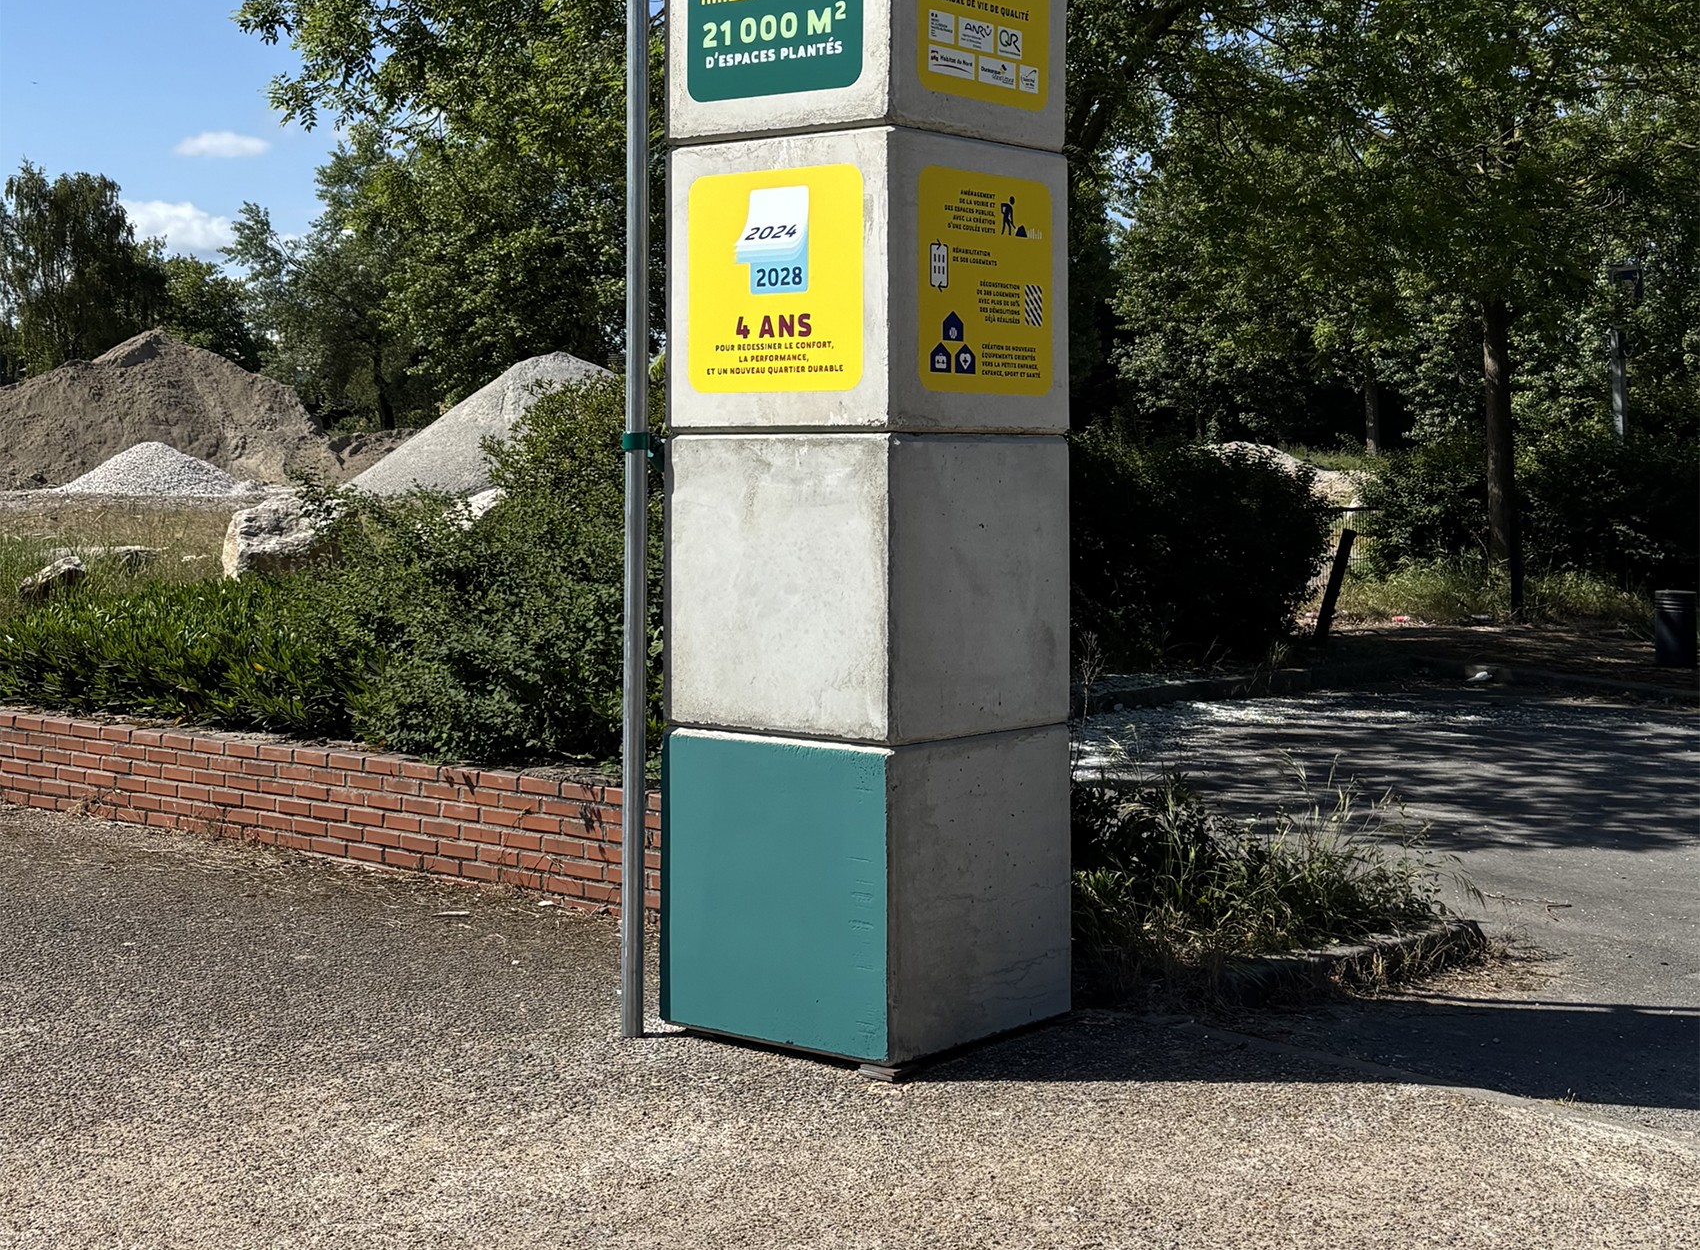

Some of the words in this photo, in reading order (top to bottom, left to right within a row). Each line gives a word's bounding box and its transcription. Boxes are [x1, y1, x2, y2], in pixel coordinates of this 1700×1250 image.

[977, 0, 988, 11] VIE
[990, 3, 999, 14] DE
[1000, 6, 1029, 21] QUALITÉ
[999, 29, 1021, 53] QR
[705, 48, 776, 69] D'ESPACES
[780, 37, 843, 60] PLANTÉS
[960, 188, 996, 199] AMÉNAGEMENT
[954, 206, 974, 214] ESPACES
[973, 216, 996, 225] CRÉATION
[744, 223, 797, 241] 2024
[962, 224, 981, 232] COULÉE
[952, 247, 991, 257] RÉHABILITATION
[969, 257, 998, 267] LOGEMENTS
[756, 266, 803, 287] 2028
[979, 279, 1020, 290] DÉCONSTRUCTION
[993, 291, 1020, 299] LOGEMENTS
[989, 306, 1020, 315] DÉMOLITIONS
[985, 314, 996, 323] DÉJÀ
[997, 315, 1020, 324] RÉALISÉES
[735, 316, 750, 339] 4
[758, 313, 812, 338] ANS
[715, 344, 735, 352] POUR
[737, 342, 782, 351] REDESSINER
[795, 341, 834, 349] CONFORT,
[981, 342, 1004, 350] CRÉATION
[739, 355, 748, 363] LA
[750, 354, 809, 362] PERFORMANCE,
[981, 350, 1013, 359] ÉQUIPEMENTS
[1014, 353, 1036, 361] ORIENTÉS
[768, 366, 806, 375] QUARTIER
[808, 364, 844, 373] DURABLE
